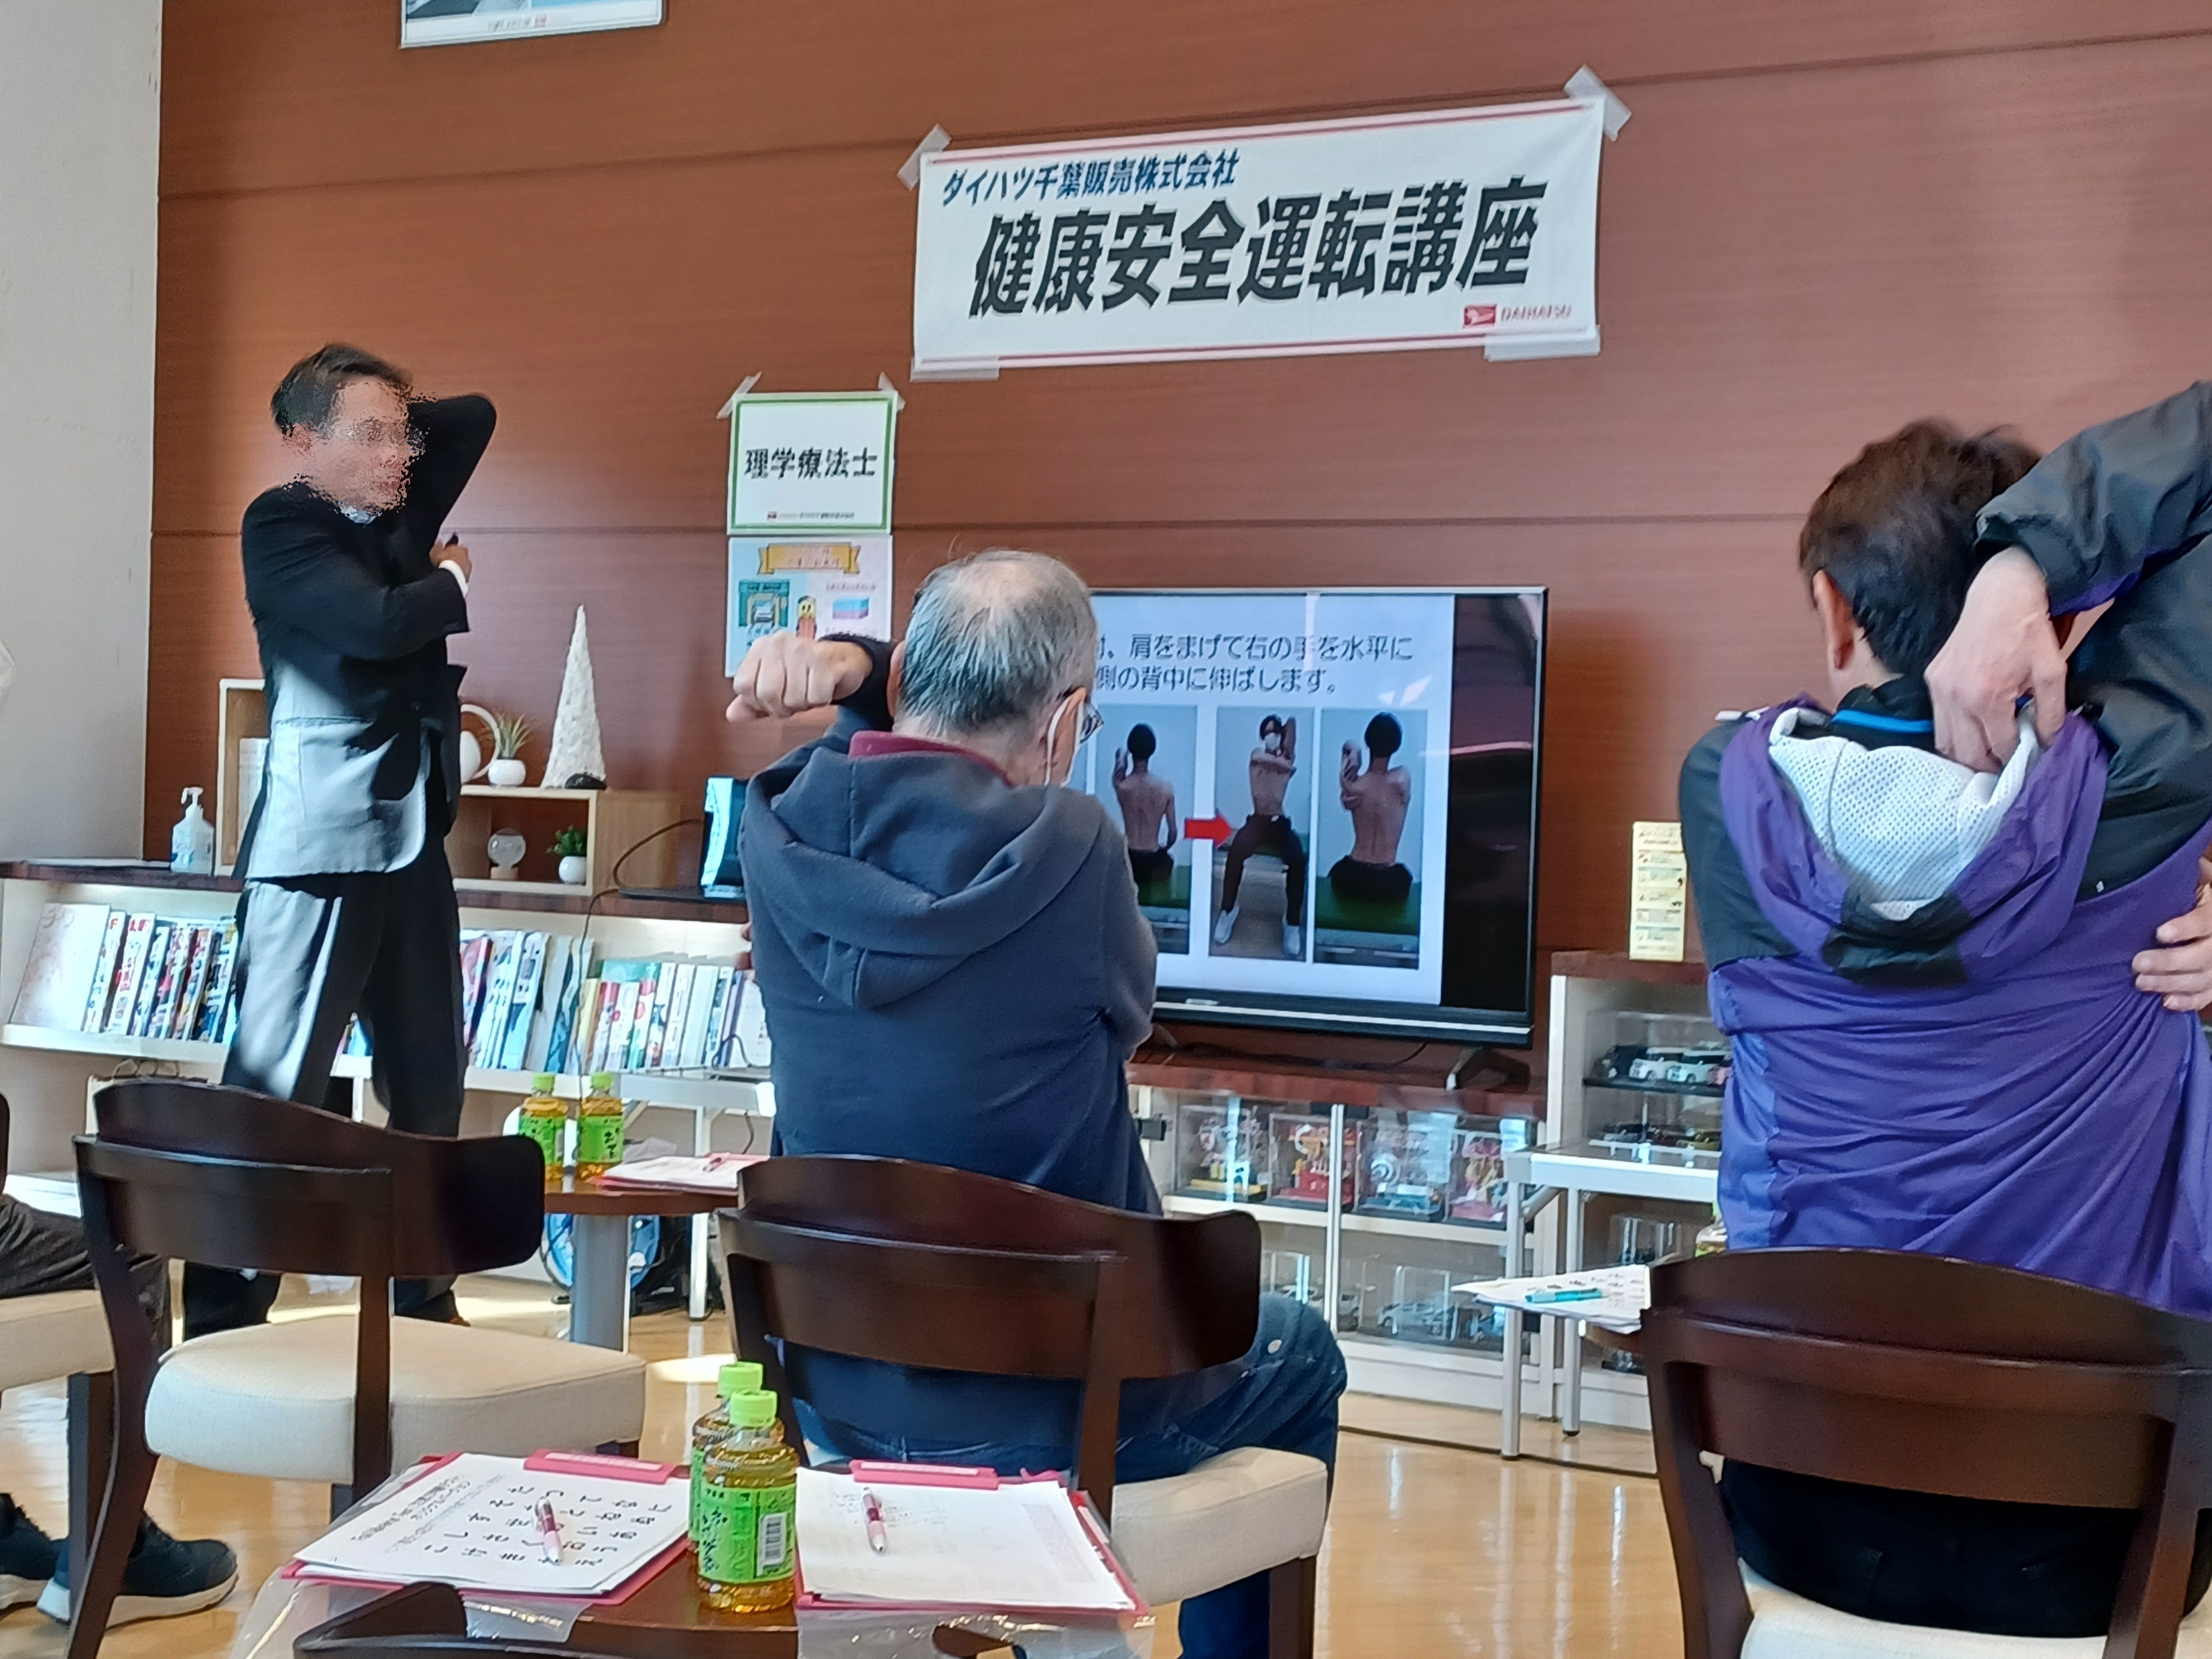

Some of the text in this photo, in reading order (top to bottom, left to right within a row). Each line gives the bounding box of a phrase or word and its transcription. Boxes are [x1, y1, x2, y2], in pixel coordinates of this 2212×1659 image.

[943, 149, 1239, 206] ダイハツ千葉販売株式会社
[968, 174, 1548, 318] 健康安全運転講座
[744, 446, 877, 479] 理学療法士
